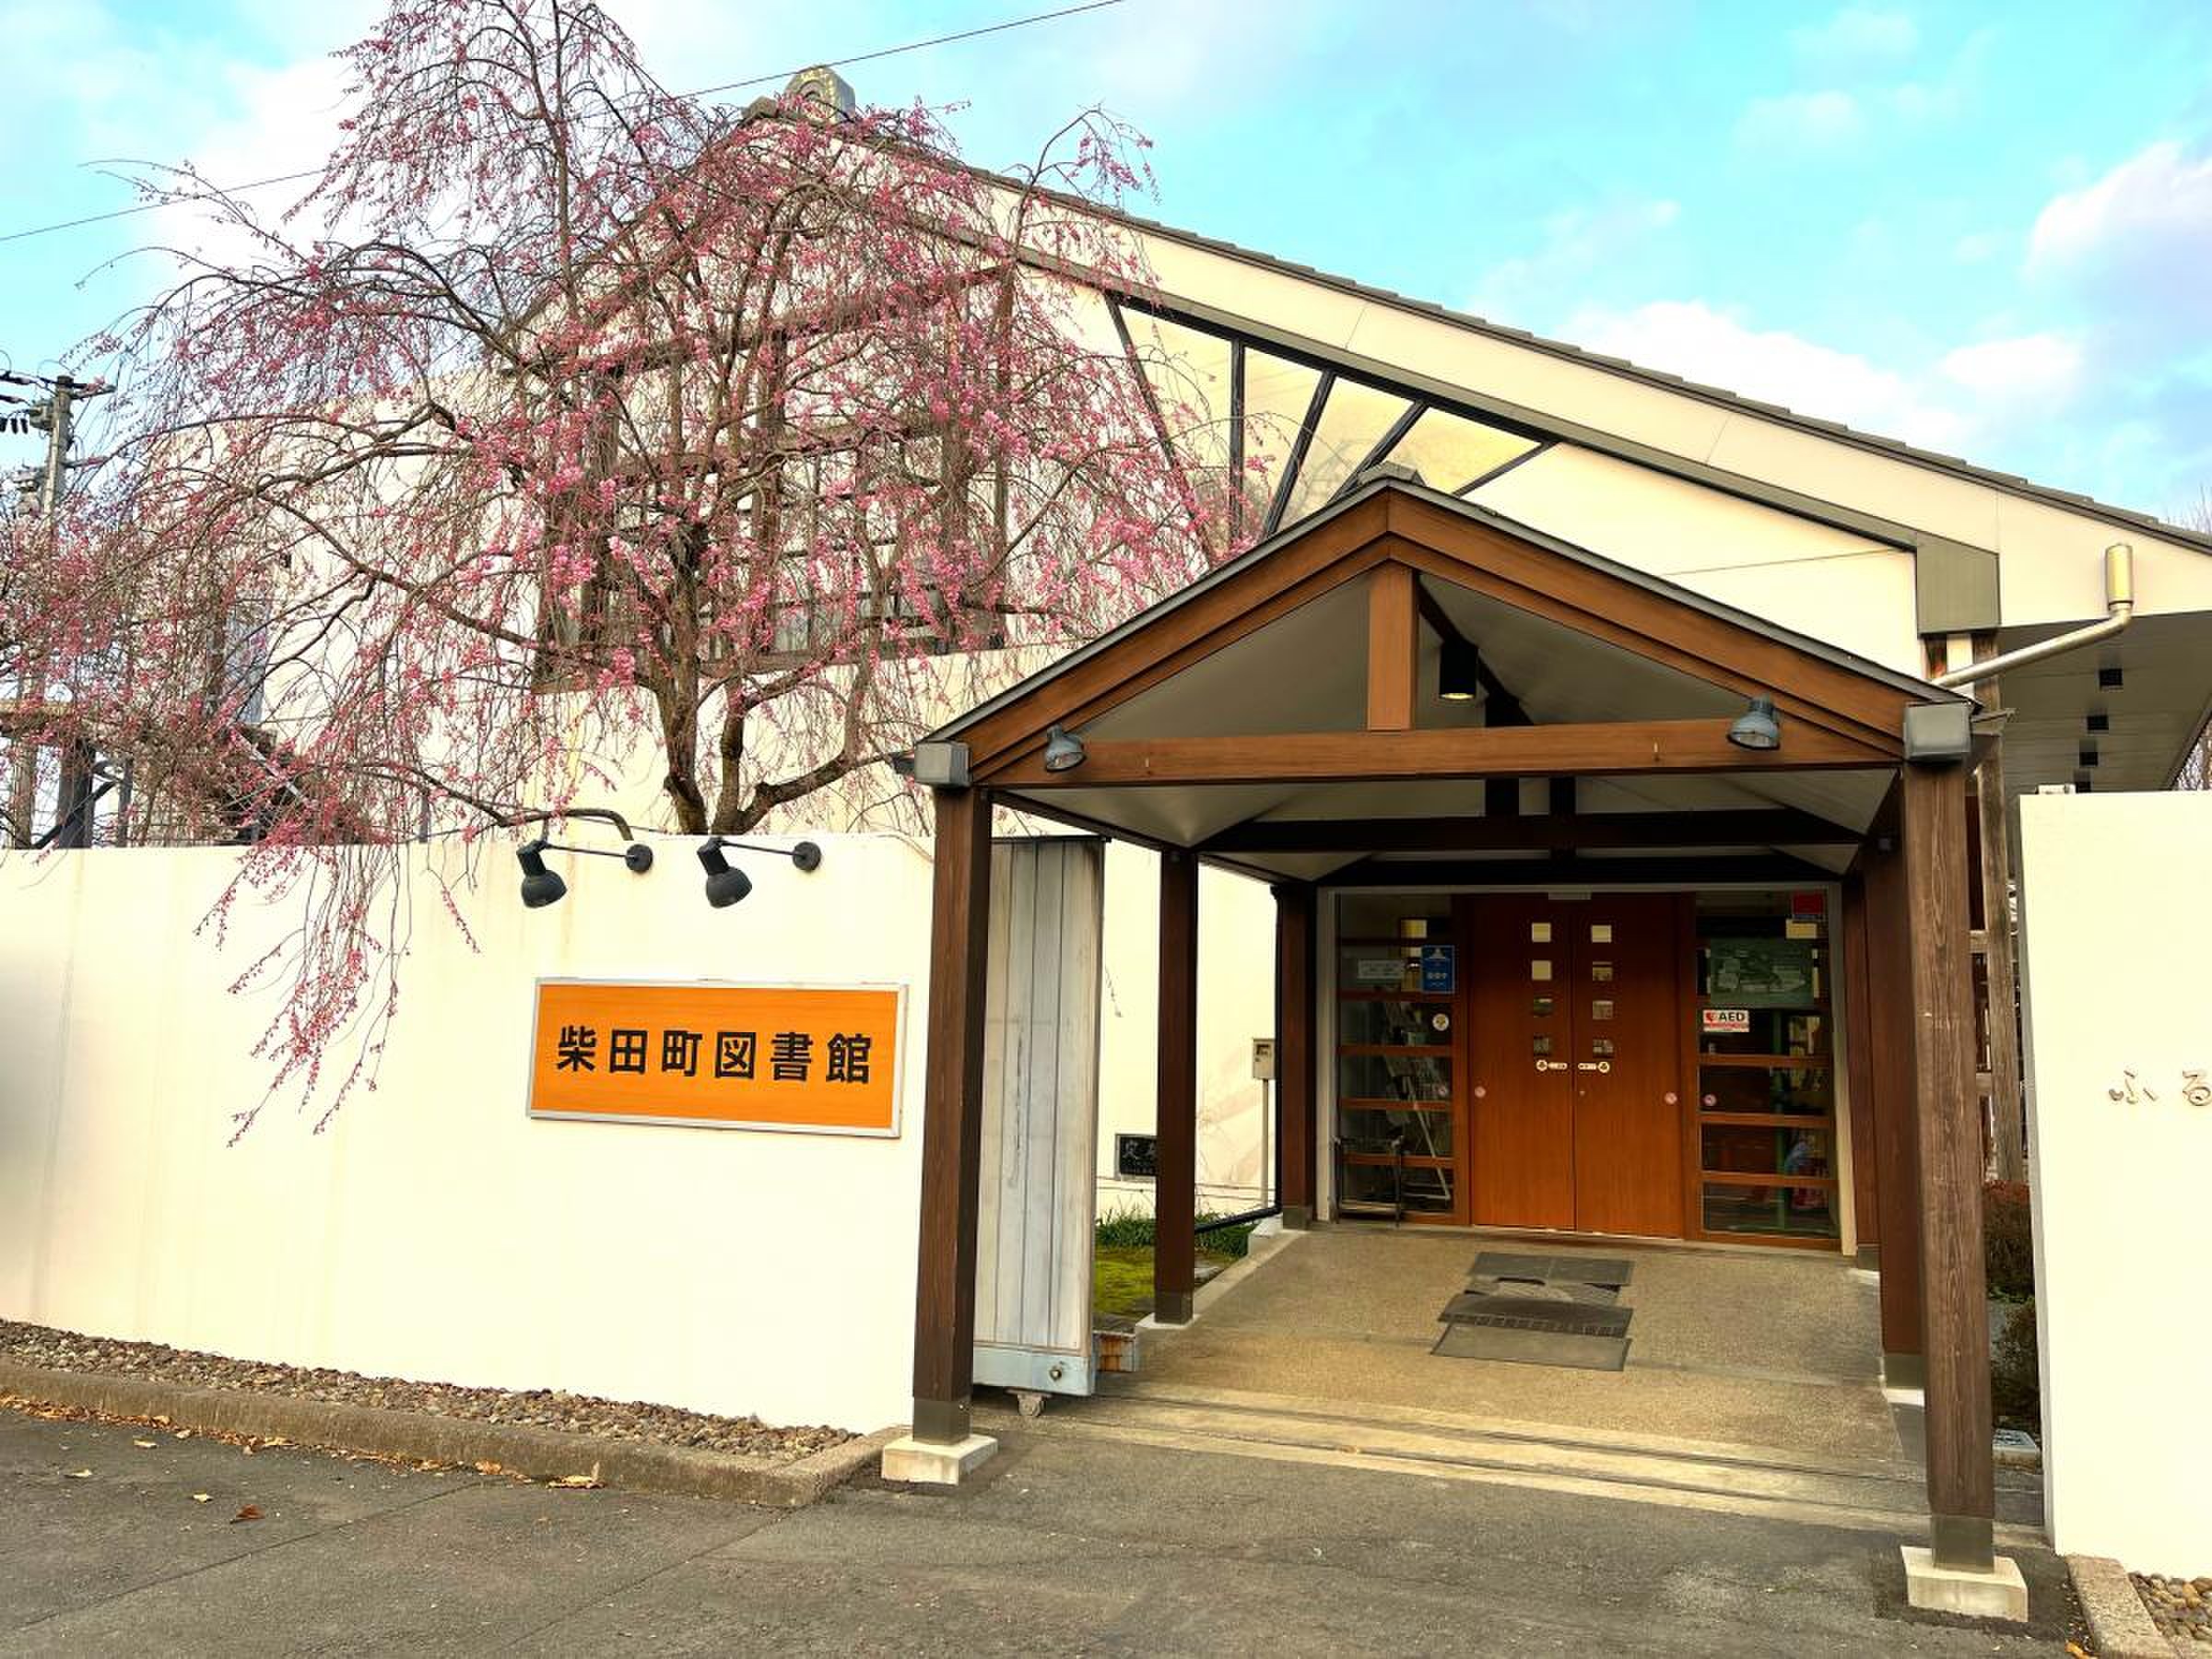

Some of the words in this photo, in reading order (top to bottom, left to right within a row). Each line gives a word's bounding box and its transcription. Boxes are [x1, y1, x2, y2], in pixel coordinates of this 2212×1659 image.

[1719, 1012, 1745, 1022] AED
[556, 1025, 871, 1084] 柴田町図書館
[2109, 1070, 2211, 1107] ふる
